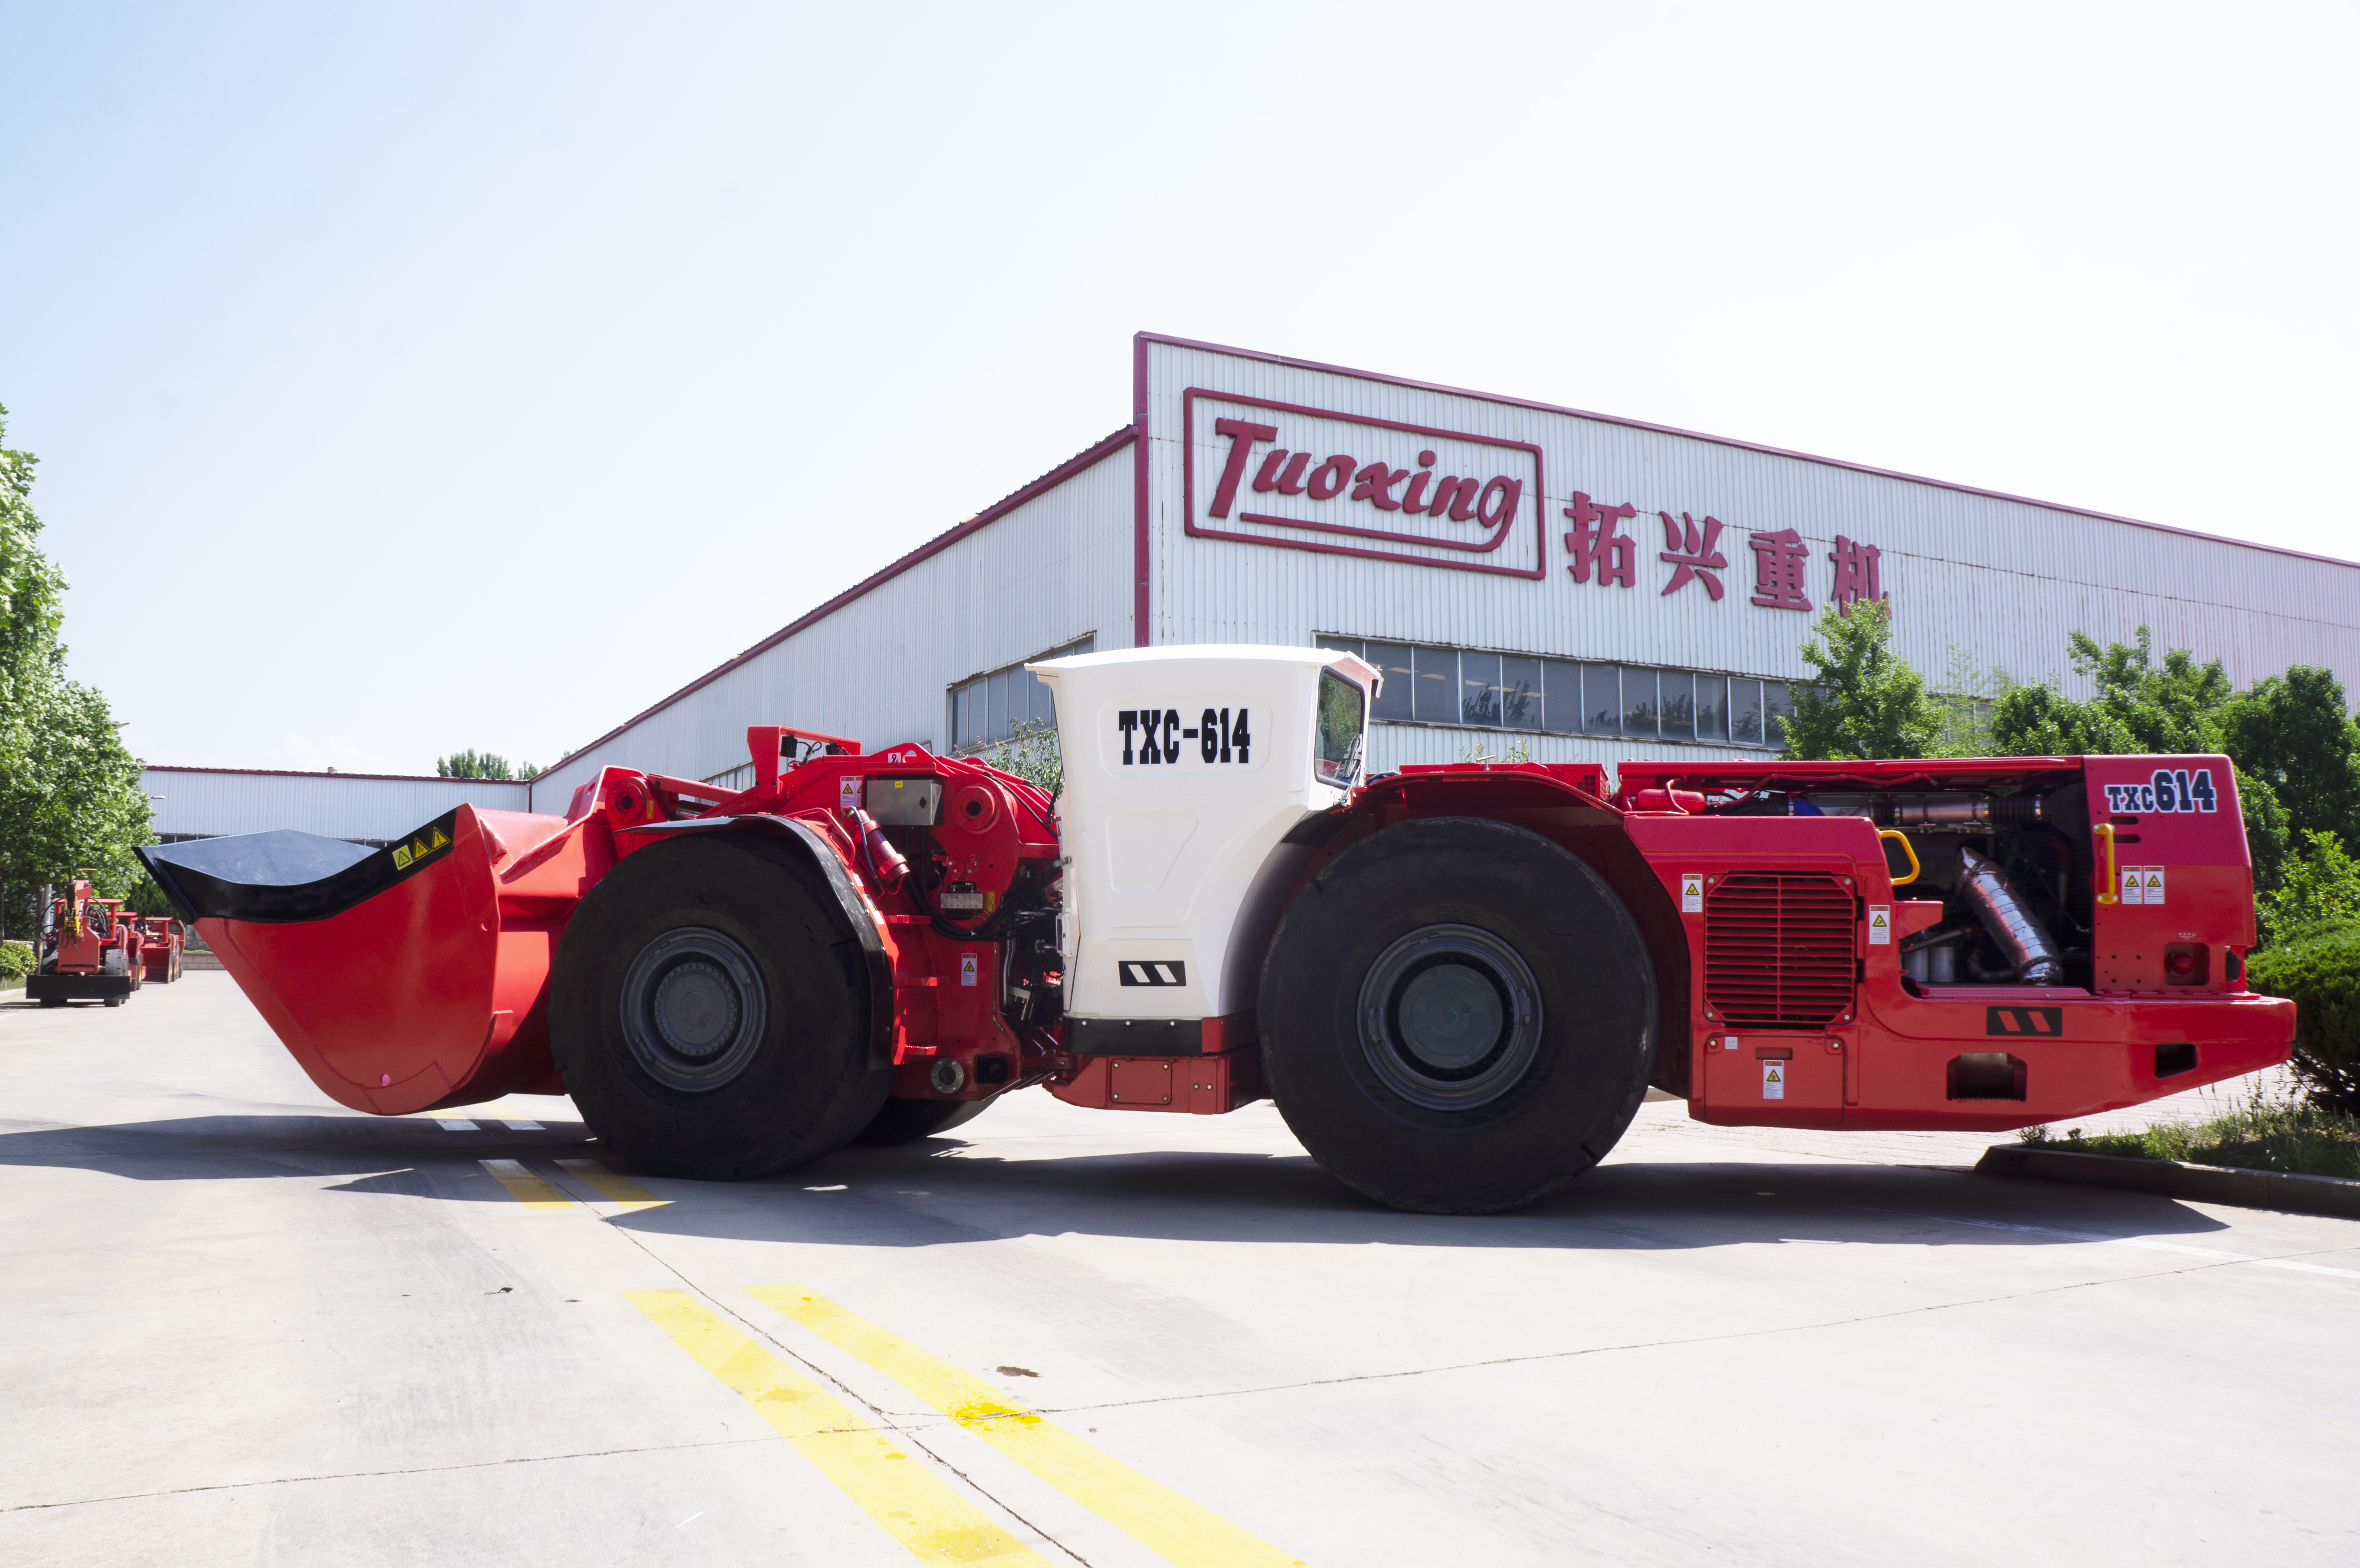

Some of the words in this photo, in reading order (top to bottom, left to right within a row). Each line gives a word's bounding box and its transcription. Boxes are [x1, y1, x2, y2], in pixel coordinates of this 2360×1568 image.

[1211, 416, 1523, 552] Tuoxing
[1564, 490, 1892, 622] 拓兴重机
[1118, 708, 1251, 765] TXC-614
[2105, 770, 2217, 812] TXC614
